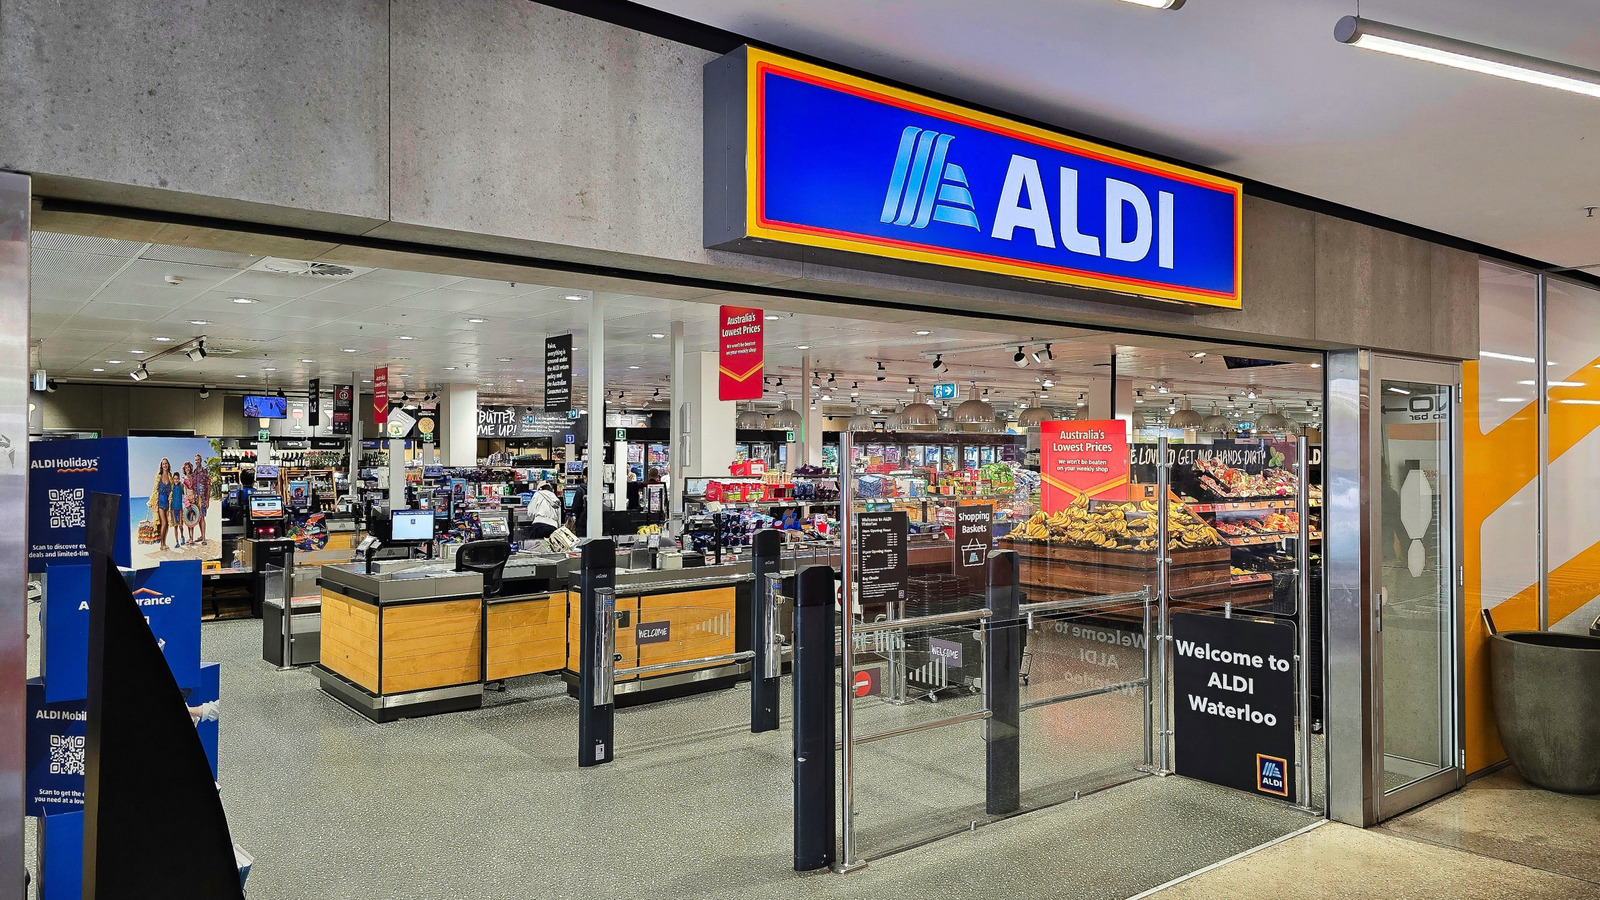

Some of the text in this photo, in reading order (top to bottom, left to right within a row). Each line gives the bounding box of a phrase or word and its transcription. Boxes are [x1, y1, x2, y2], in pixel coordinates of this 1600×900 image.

[991, 154, 1174, 269] ALDI
[727, 312, 756, 326] Australia's
[722, 324, 761, 337] Lowest Prices
[478, 410, 516, 424] BUTTER
[477, 425, 495, 435] ME
[498, 424, 517, 437] UP!
[1060, 429, 1105, 440] Australia's
[1053, 441, 1113, 452] Lowest Prices
[30, 457, 98, 469] ALDI Holidays
[1178, 449, 1196, 465] GET
[1216, 450, 1242, 465] HANDS
[1244, 450, 1266, 465] DIRTY
[1096, 466, 1109, 474] shop
[958, 511, 990, 522] Shopping
[962, 524, 987, 534] Baskets
[638, 627, 668, 639] WELCOME
[931, 645, 958, 659] WELCOME
[1176, 639, 1290, 672] Welcome to
[1207, 672, 1254, 695] ALDI
[36, 710, 60, 719] ALDI
[1188, 694, 1277, 727] Waterloo
[1262, 777, 1283, 788] ALDI
